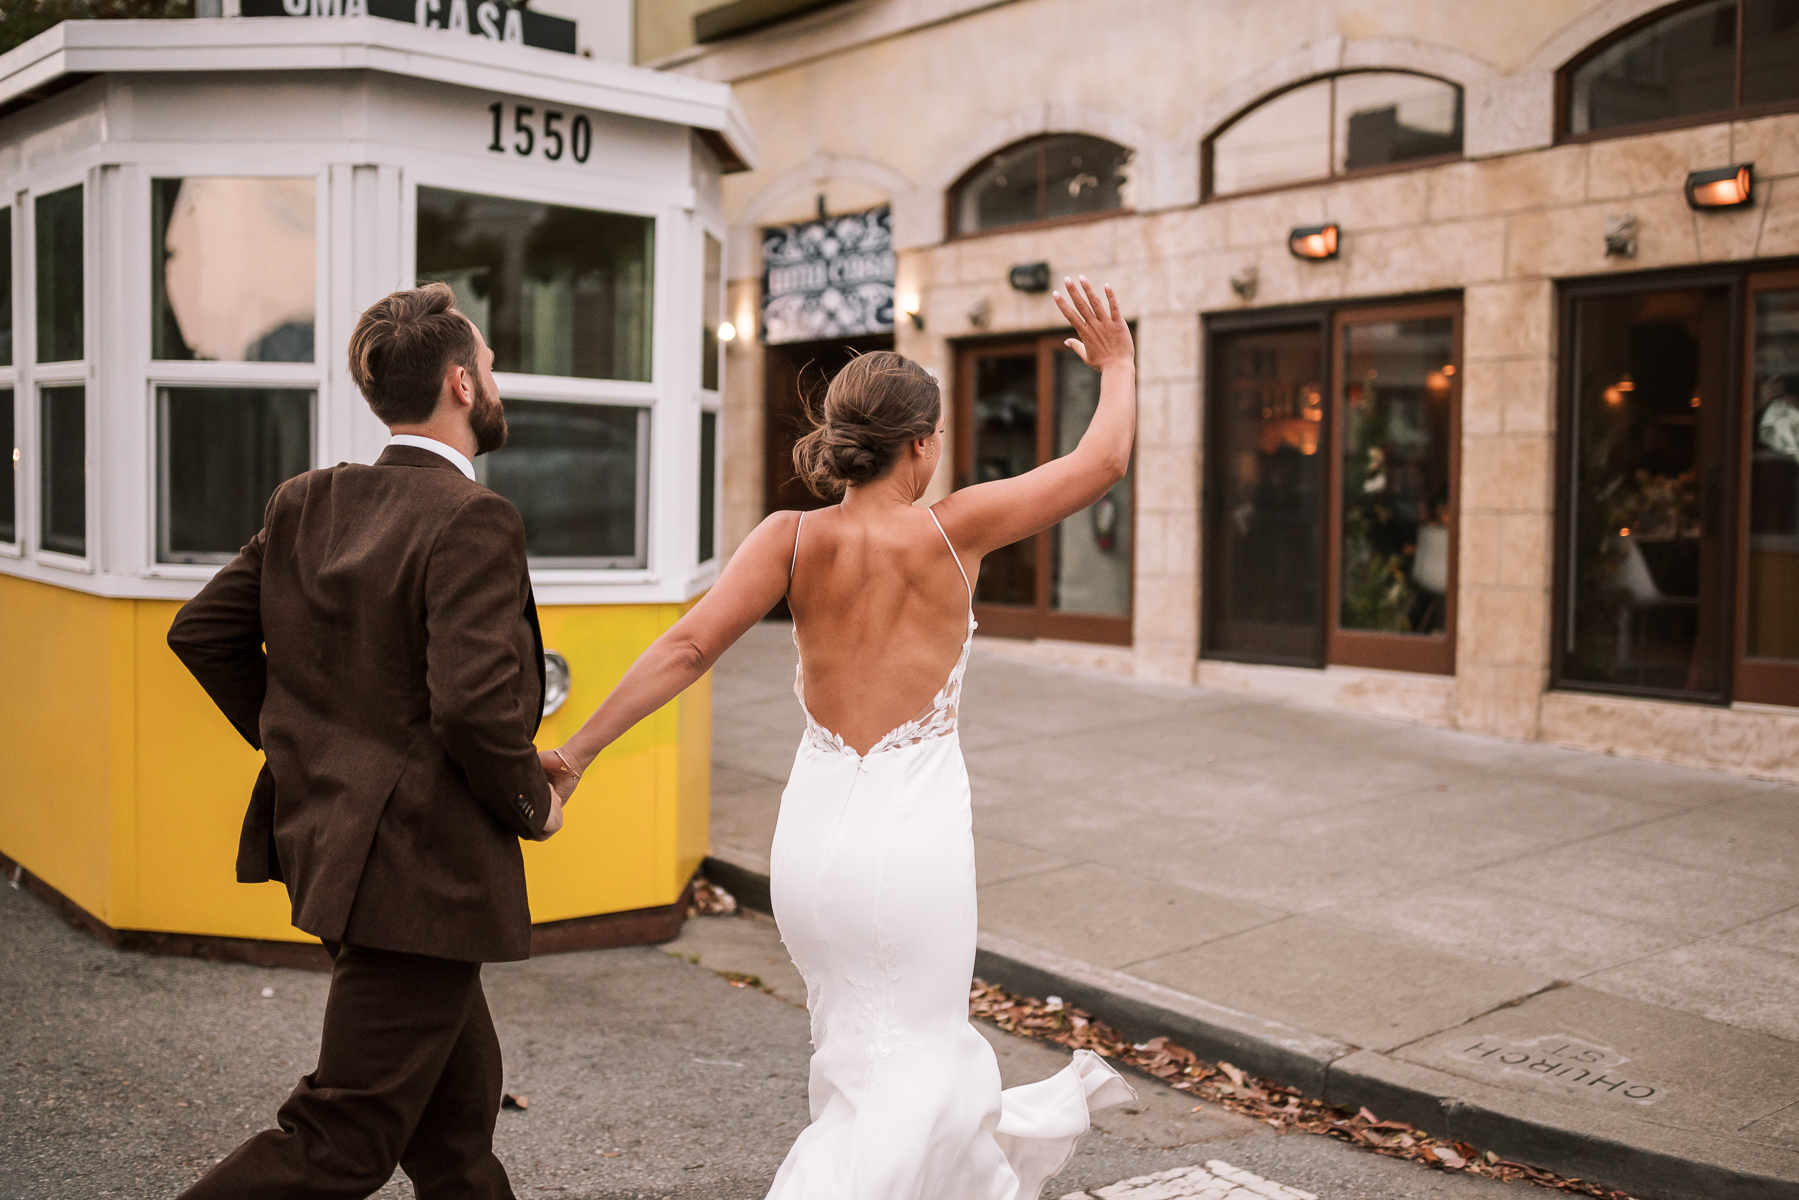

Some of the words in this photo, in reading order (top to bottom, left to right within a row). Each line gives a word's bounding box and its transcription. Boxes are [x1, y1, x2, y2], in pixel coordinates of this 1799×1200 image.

[414, 0, 525, 44] CASA
[488, 102, 592, 164] 1550
[1464, 1042, 1655, 1098] CHURCH
[1542, 1045, 1606, 1063] ST
